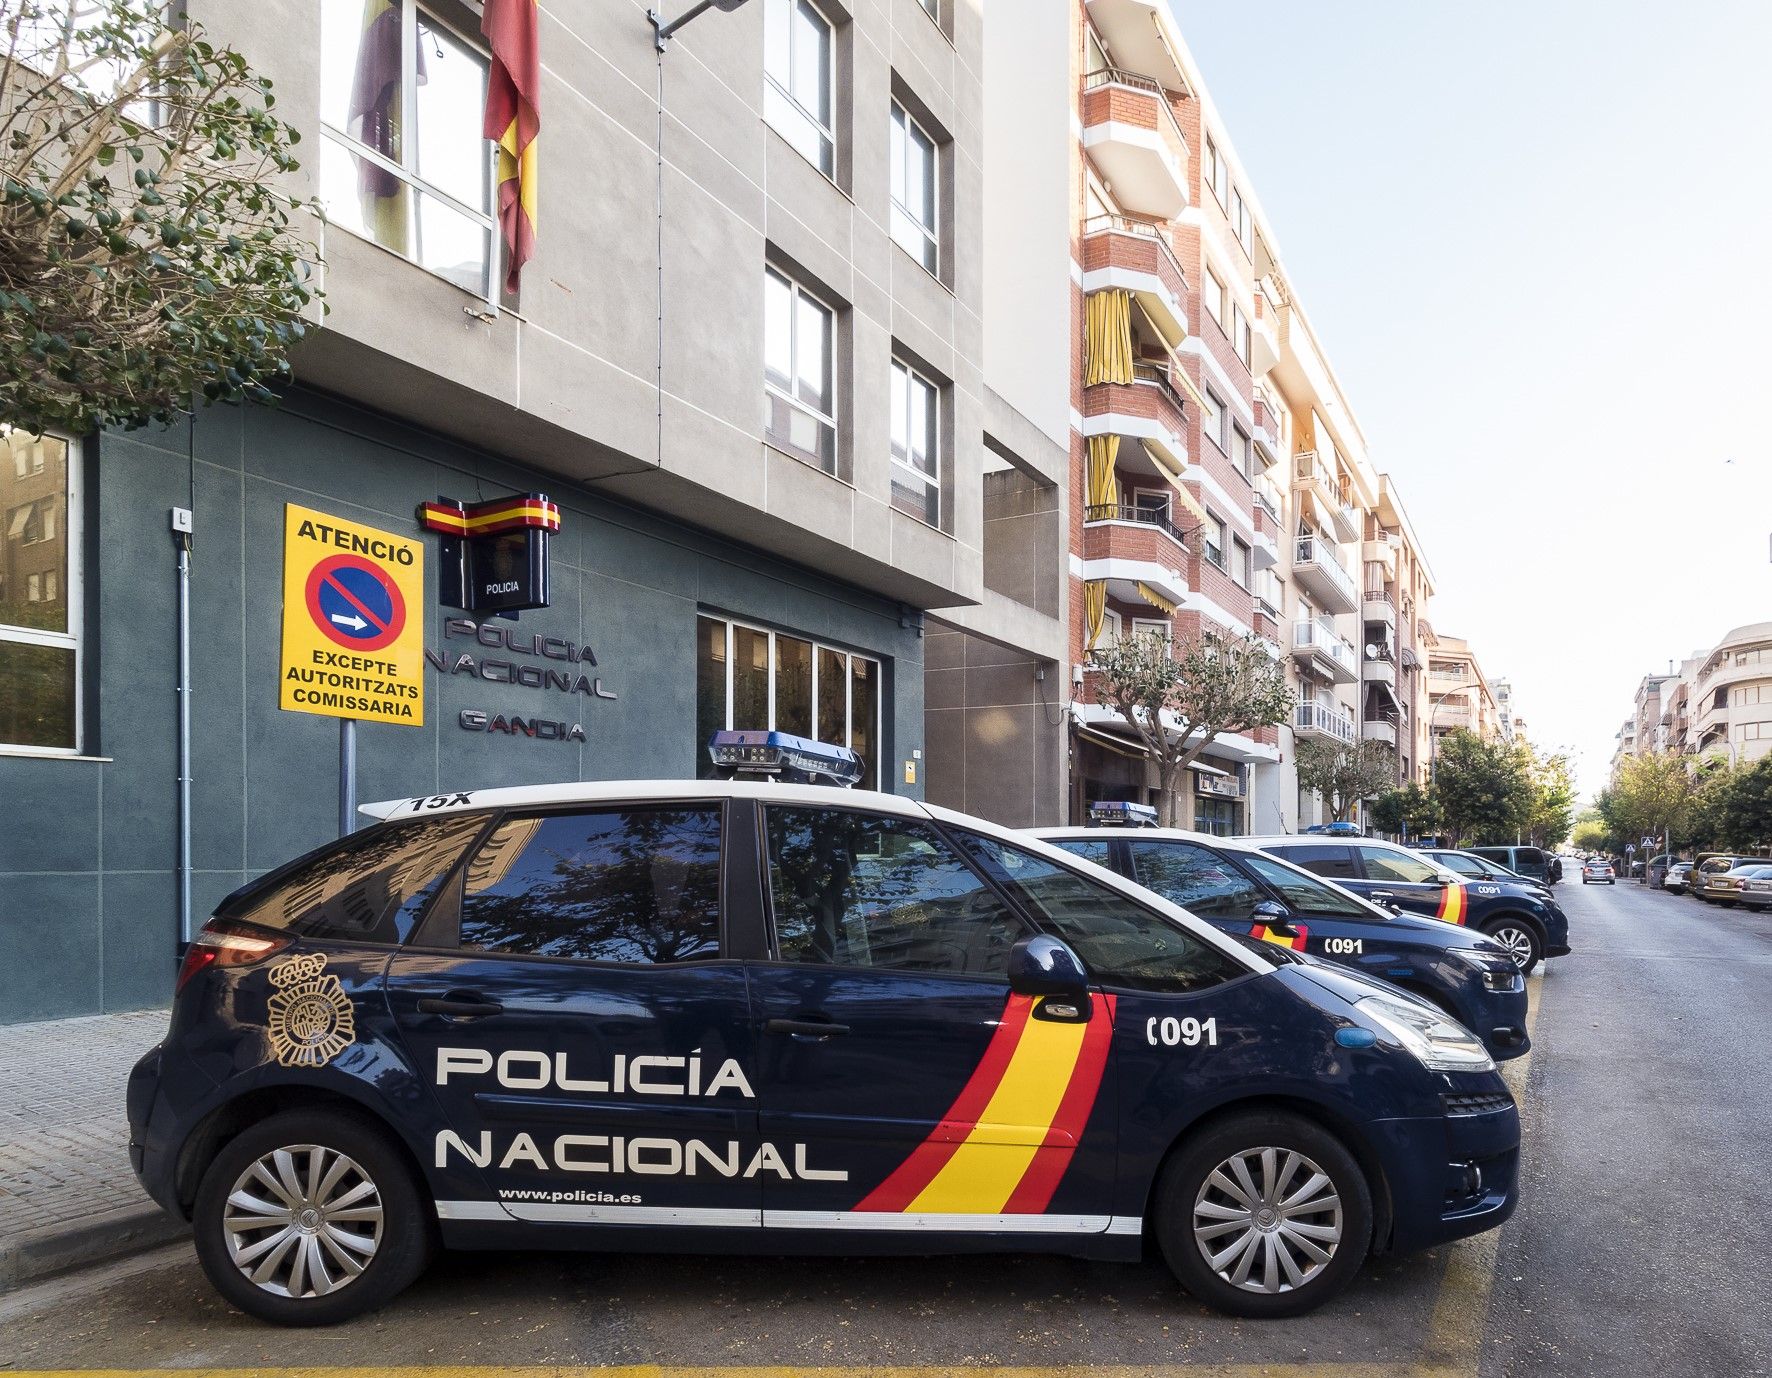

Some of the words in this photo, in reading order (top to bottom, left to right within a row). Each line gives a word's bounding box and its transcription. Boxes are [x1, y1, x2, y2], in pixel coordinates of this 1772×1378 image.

[297, 519, 414, 566] ATENCIÓ
[486, 581, 520, 595] POLICIA
[312, 649, 397, 676] EXCEPTE
[424, 647, 618, 700] NACIONAL
[286, 666, 419, 699] AUTORITZATS
[293, 688, 413, 718] COMISSARIA
[459, 709, 587, 743] GANDIA
[410, 792, 474, 811] 15X
[1331, 938, 1363, 954] 091
[1160, 1016, 1217, 1046] 091
[436, 1047, 756, 1098] POLICÍA
[435, 1129, 848, 1181] NACIONAL
[499, 1188, 642, 1204] www.policia.es
